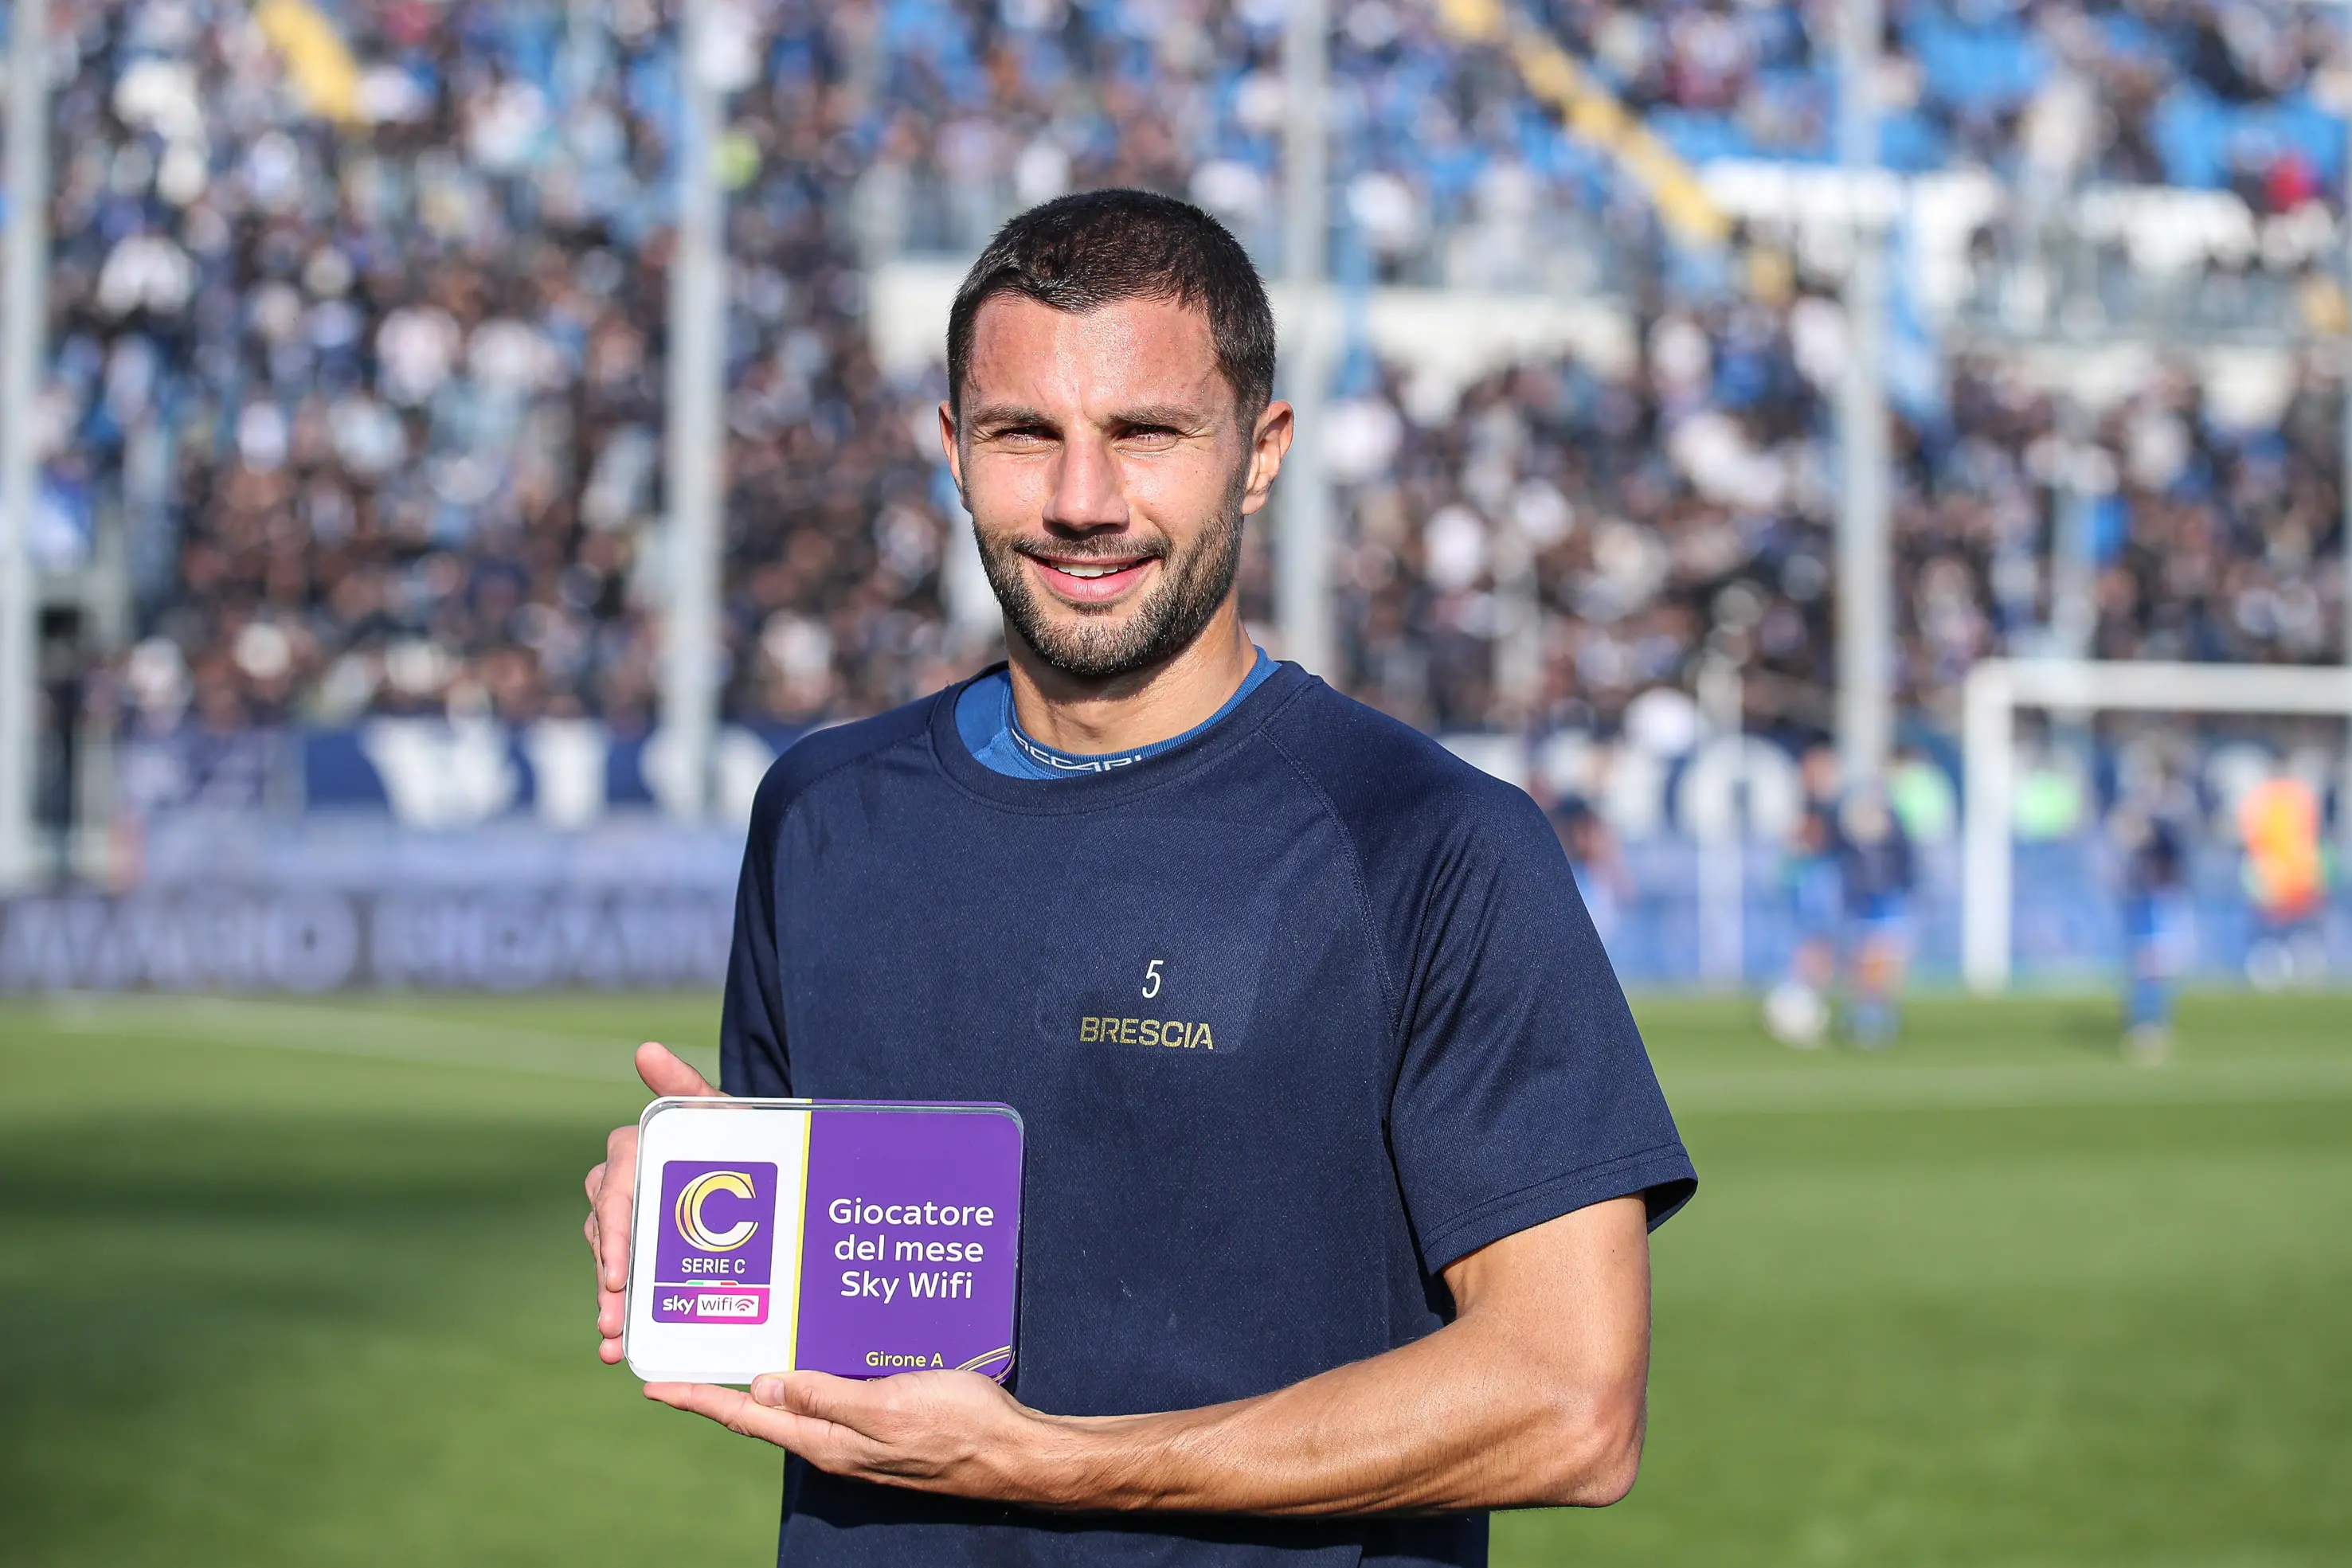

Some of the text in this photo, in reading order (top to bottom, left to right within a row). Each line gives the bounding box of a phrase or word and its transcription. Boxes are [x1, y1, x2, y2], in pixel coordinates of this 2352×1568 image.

[1141, 959, 1164, 999] 5
[1079, 1016, 1214, 1050] BRESCIA
[675, 1170, 759, 1253] C
[828, 1197, 995, 1226] Giocatore
[834, 1234, 984, 1263] del mese
[681, 1257, 746, 1274] SERIE C
[840, 1270, 972, 1304] Sky Wifi
[662, 1294, 733, 1316] sky wifi
[865, 1351, 944, 1367] Girone A
